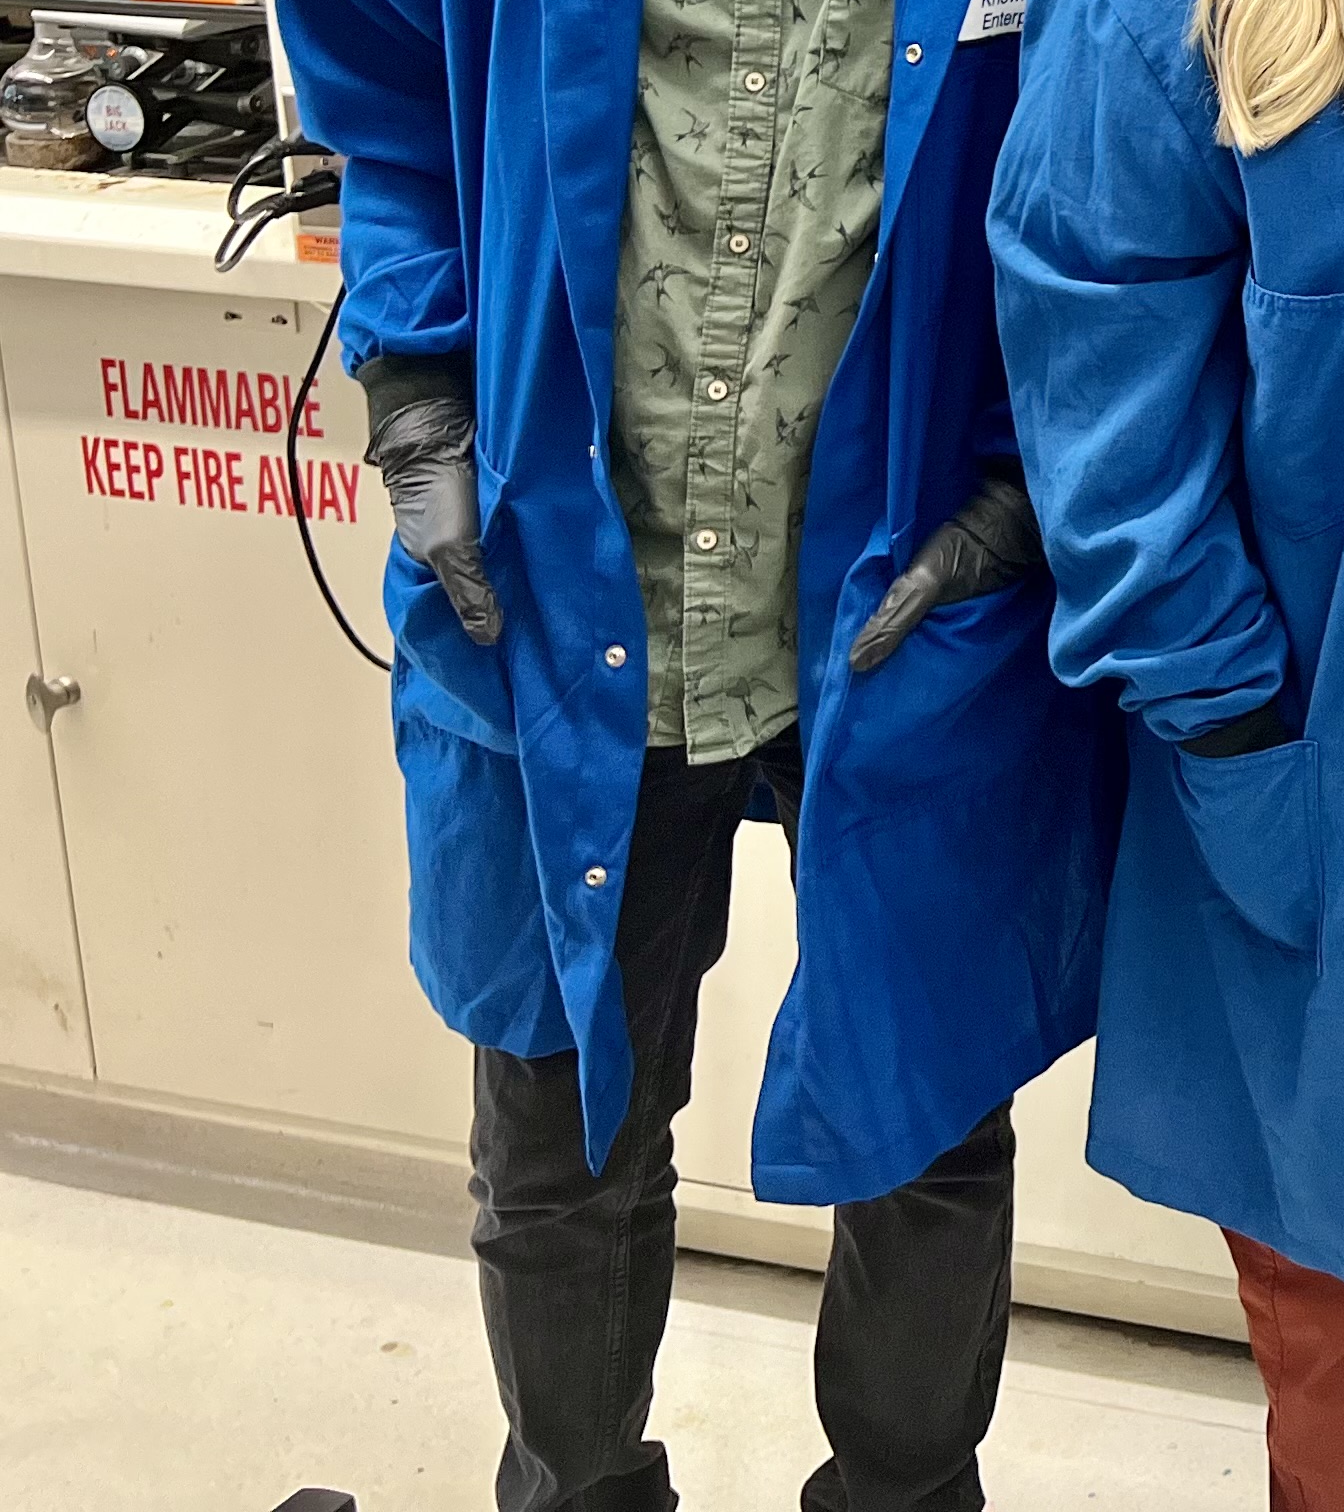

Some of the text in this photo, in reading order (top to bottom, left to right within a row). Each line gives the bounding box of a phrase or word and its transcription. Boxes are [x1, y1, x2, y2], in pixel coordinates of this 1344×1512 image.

[982, 12, 1025, 30] Enterp
[100, 357, 324, 438] FLAMMABLE
[81, 435, 360, 524] KEEP FIRE AWAY
